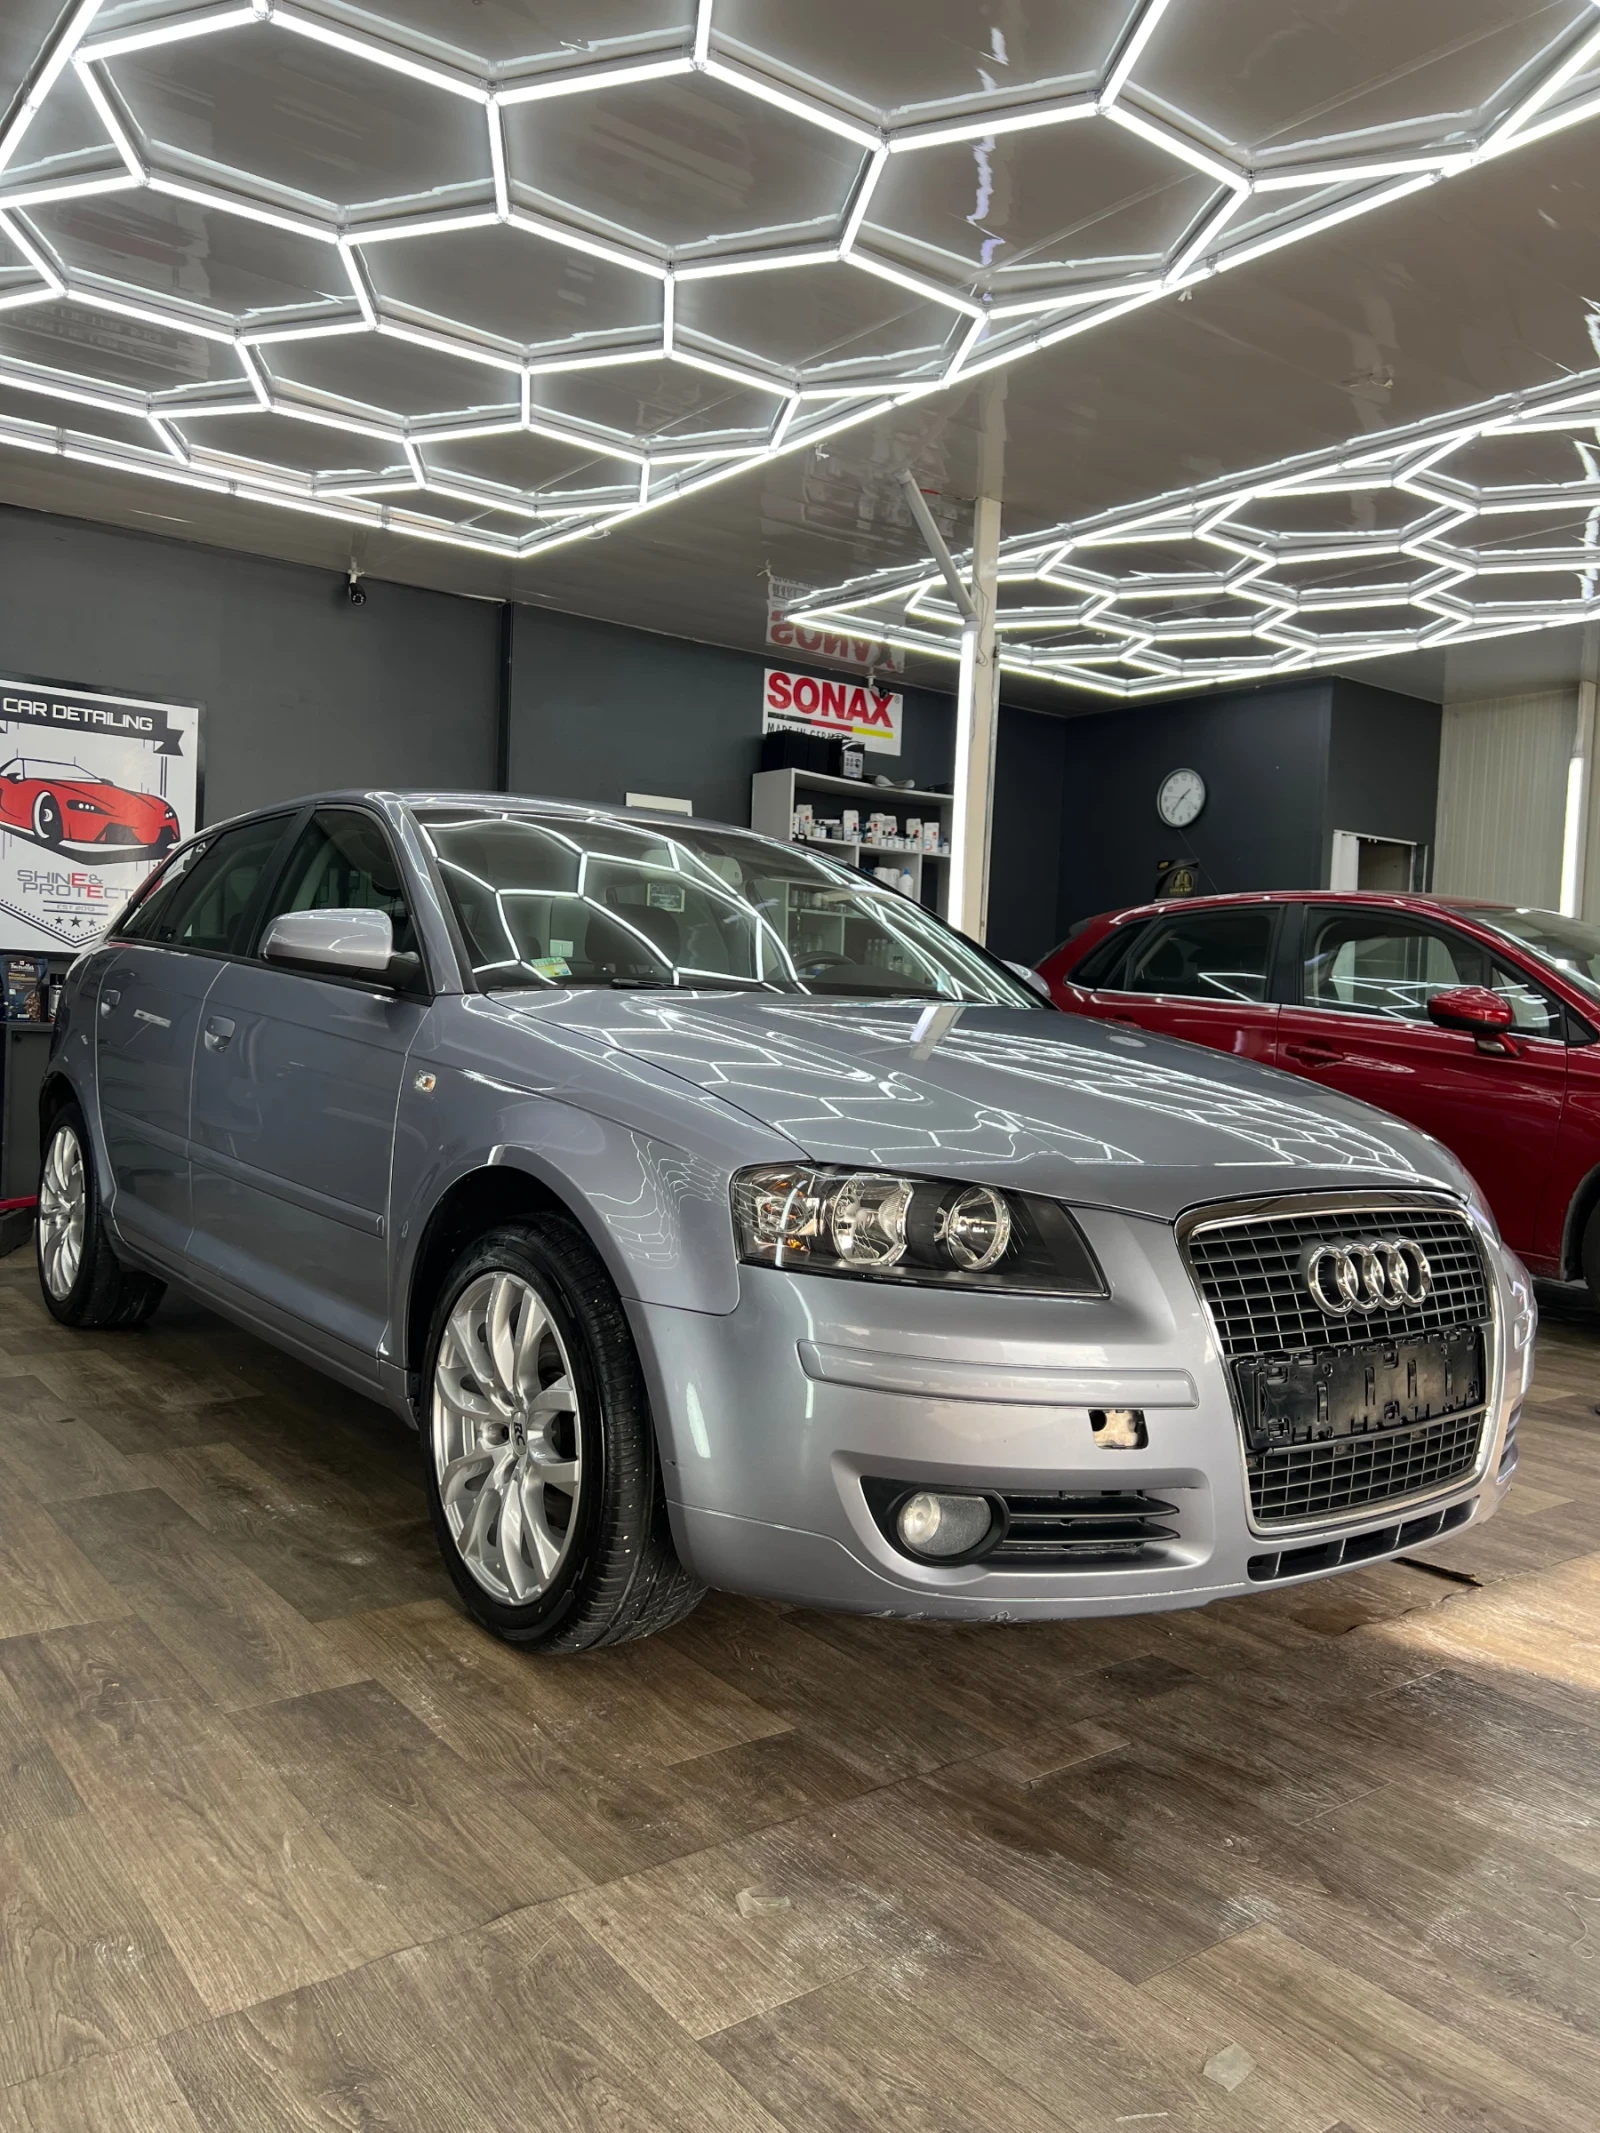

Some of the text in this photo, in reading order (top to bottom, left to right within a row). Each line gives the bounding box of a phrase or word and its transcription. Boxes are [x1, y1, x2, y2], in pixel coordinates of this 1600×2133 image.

[767, 672, 894, 728] SONAX
[3, 697, 153, 731] CAR DETAILING
[17, 869, 88, 887] SHINE
[22, 882, 134, 900] PROTECT
[513, 1422, 526, 1446] RC
